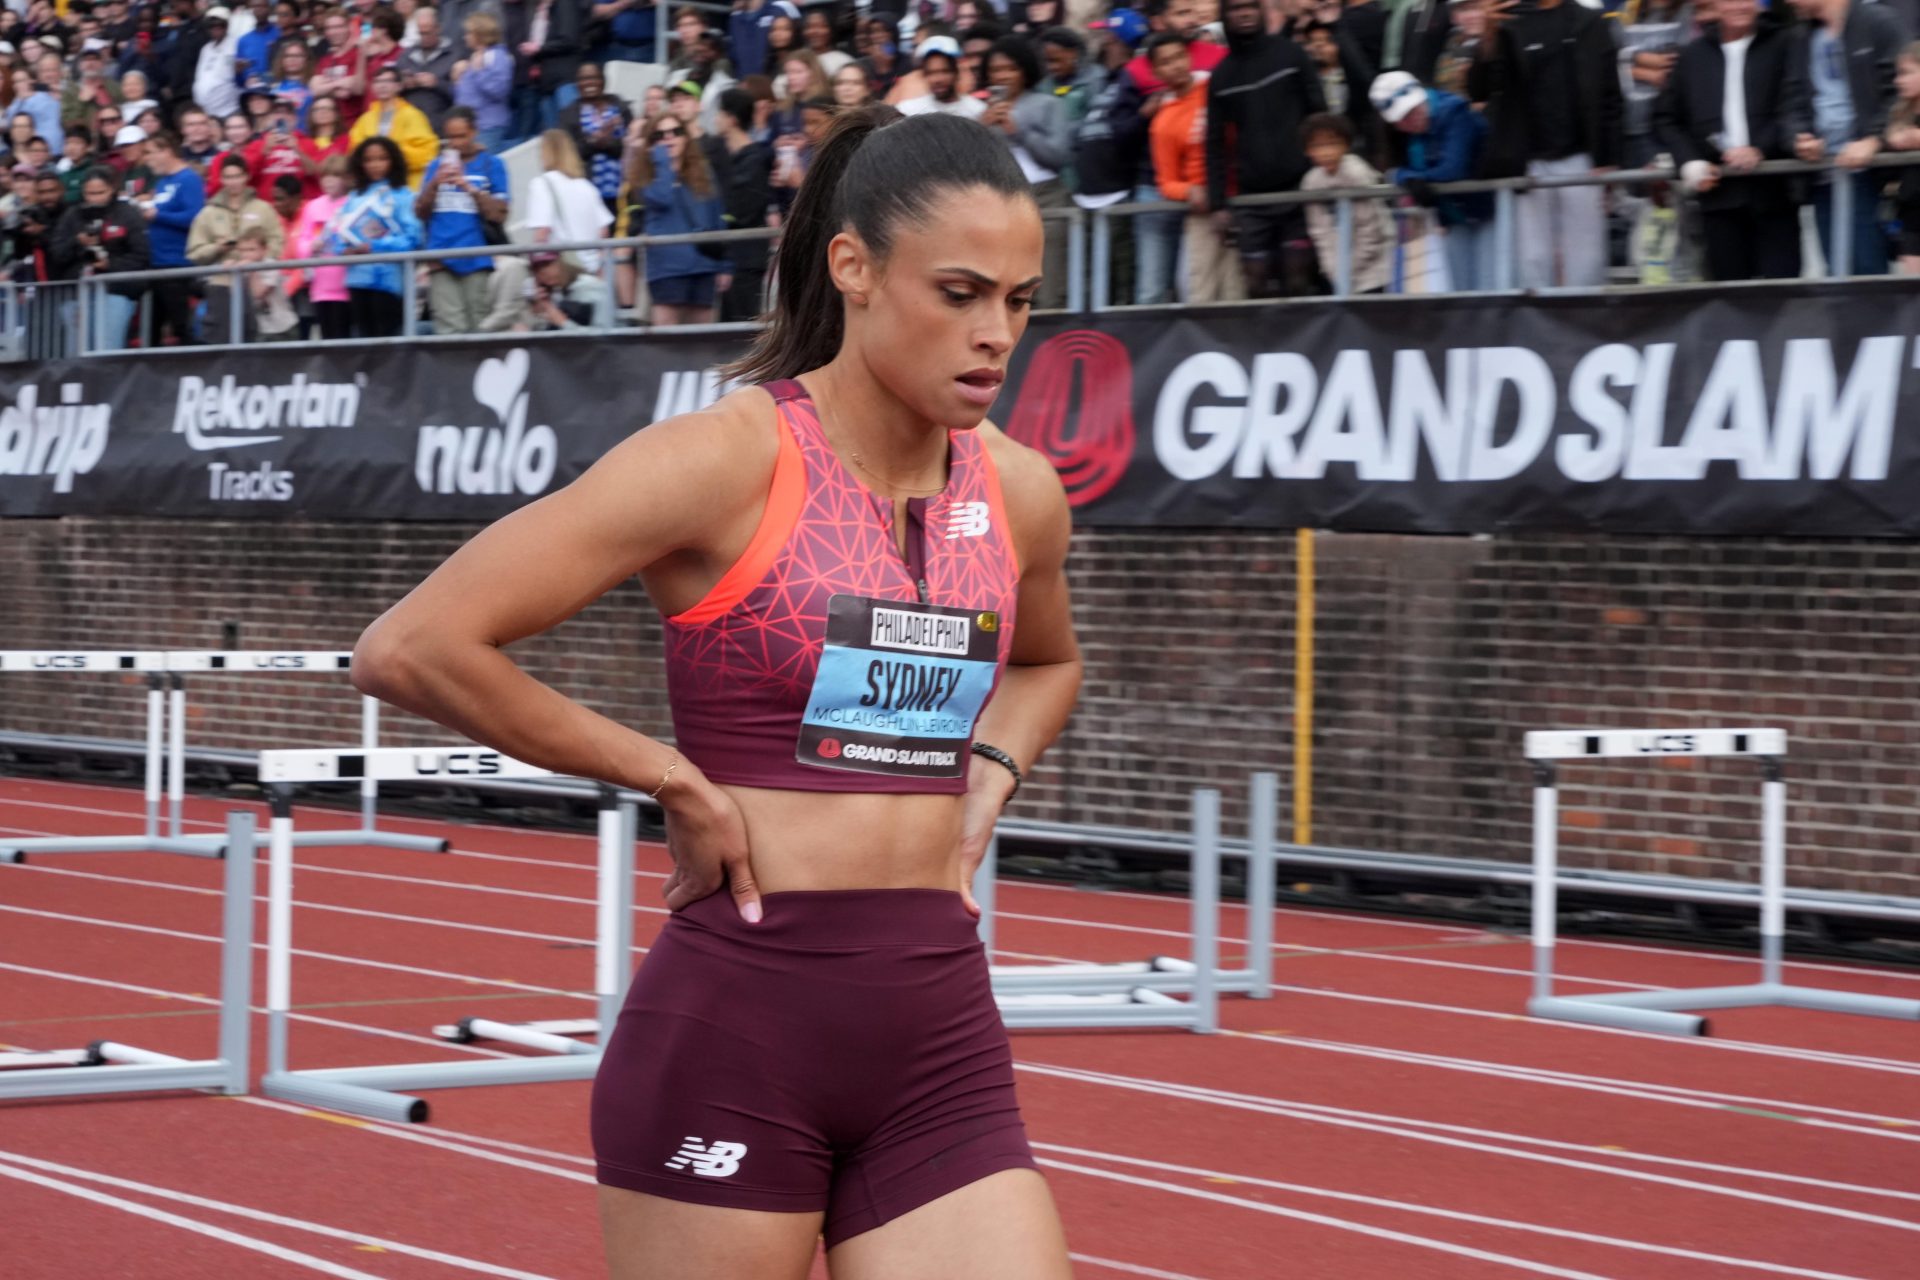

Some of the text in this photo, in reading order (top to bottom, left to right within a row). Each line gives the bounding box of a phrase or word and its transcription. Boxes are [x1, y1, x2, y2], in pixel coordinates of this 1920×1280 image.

[172, 373, 360, 450] Rekortan
[1153, 335, 1906, 483] GRAND SLAM
[0, 383, 111, 493] drip
[415, 392, 558, 495] nulo
[208, 461, 295, 501] Tracks
[875, 612, 966, 650] PHILADELPHIA
[31, 655, 86, 668] UCS
[254, 655, 306, 668] UCS
[859, 659, 963, 712] SYDNEY
[842, 743, 898, 764] GRAND
[897, 748, 931, 766] SLAM
[1634, 735, 1694, 752] UCS
[414, 754, 500, 775] UCS
